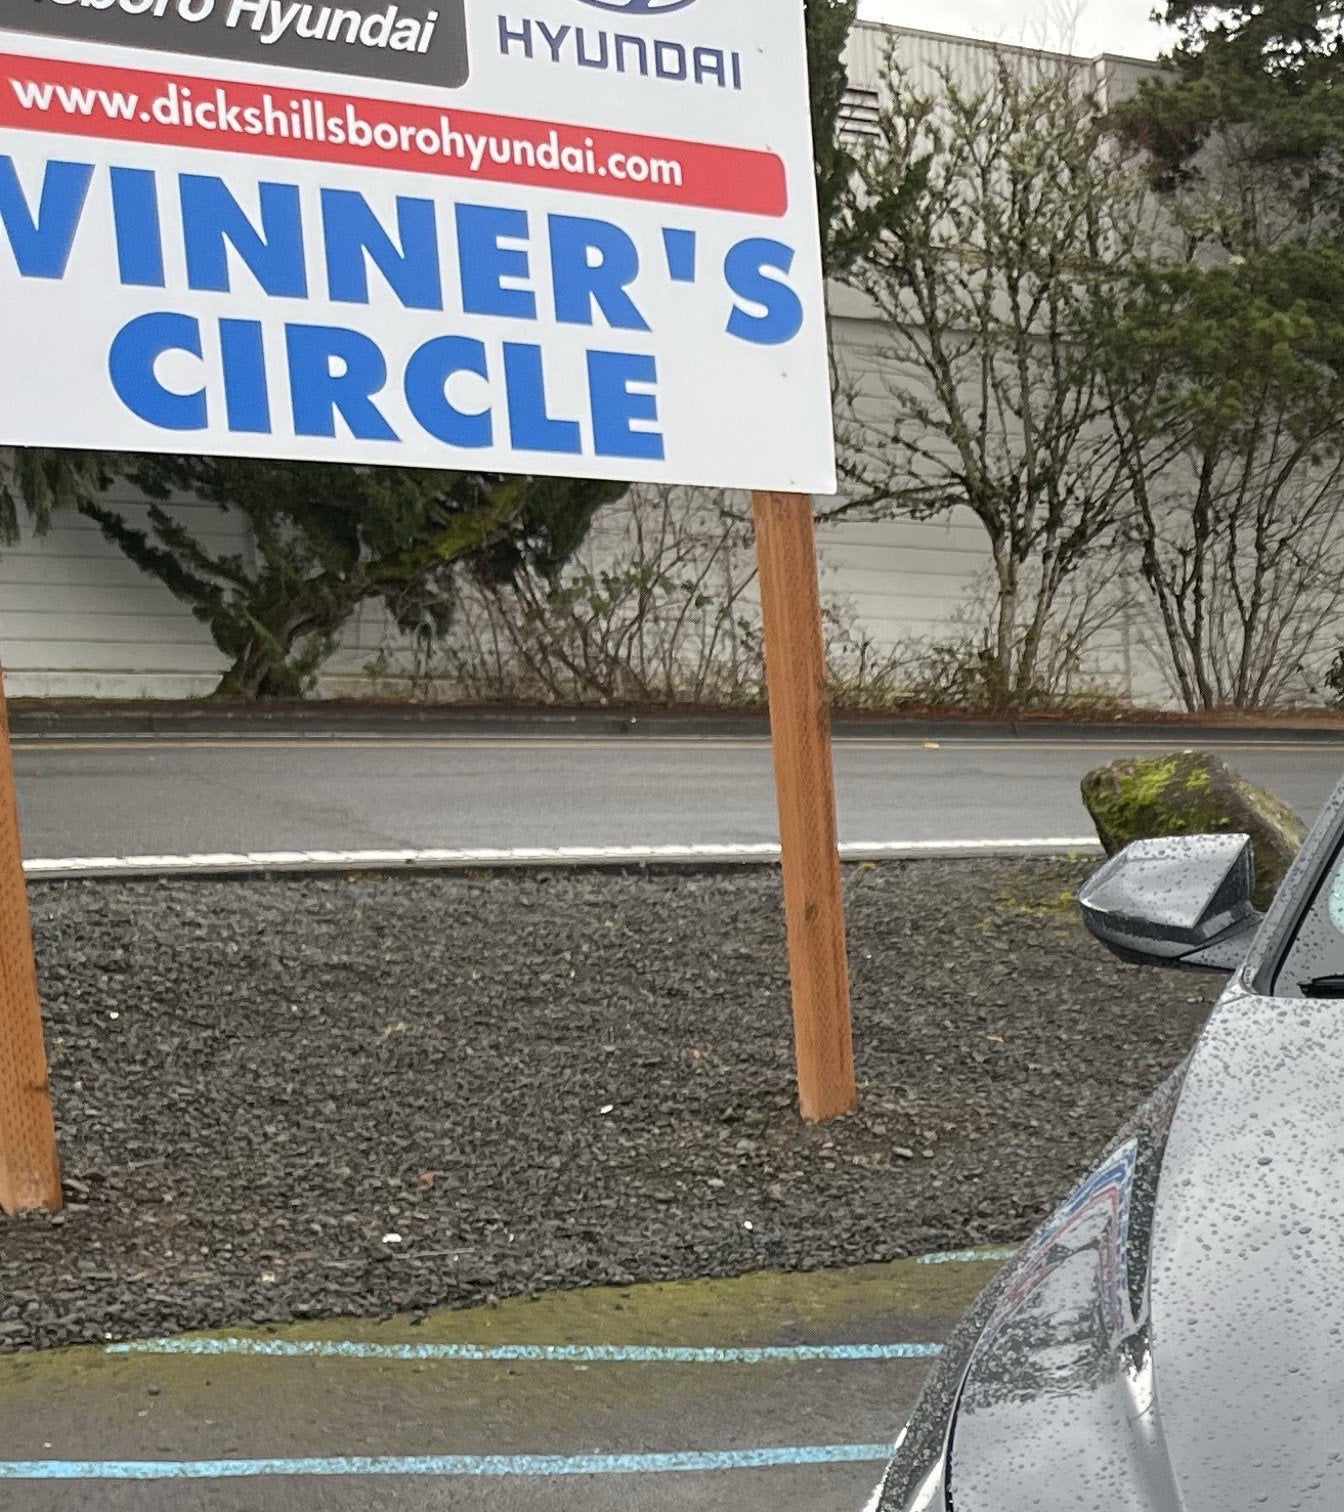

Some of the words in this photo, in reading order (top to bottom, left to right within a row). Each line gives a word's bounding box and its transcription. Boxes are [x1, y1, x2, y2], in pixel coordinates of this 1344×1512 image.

[226, 0, 439, 54] Hyundai
[497, 14, 743, 90] HYUNDAI
[10, 77, 684, 187] www.dickshillsborohyundai.com
[108, 312, 666, 460] CIRCLE
